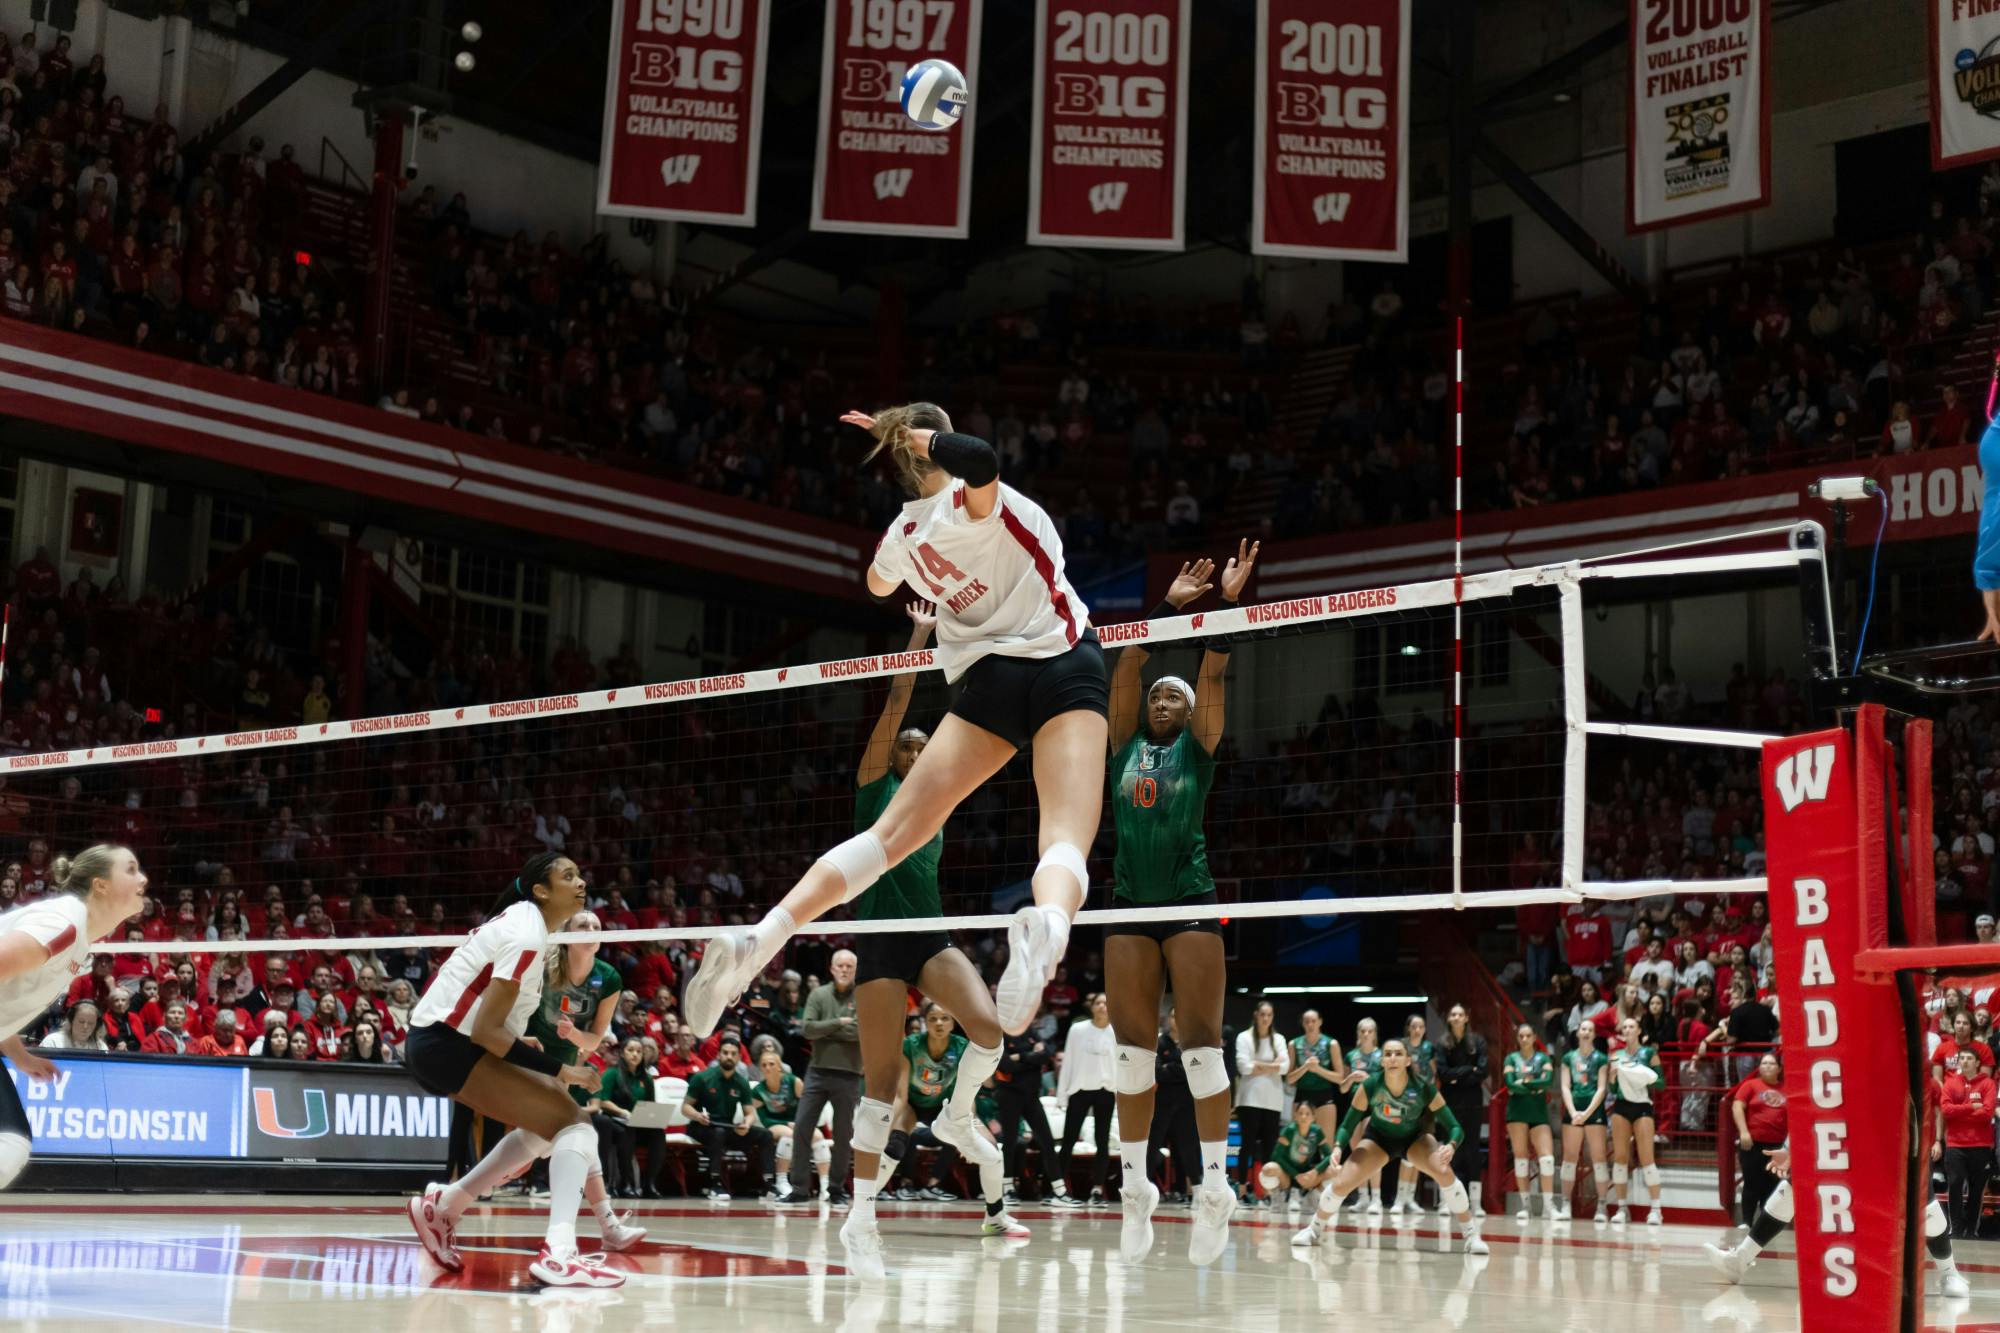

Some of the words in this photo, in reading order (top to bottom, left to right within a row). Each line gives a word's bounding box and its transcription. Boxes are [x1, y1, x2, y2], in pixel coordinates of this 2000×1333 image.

[847, 0, 955, 52] 1997
[1054, 11, 1170, 66] 2000
[1280, 19, 1383, 77] 2001
[1648, 32, 1747, 70] VOLLEYBALL
[1647, 53, 1747, 98] FINALIST
[629, 94, 740, 121] VOLLEYBALL
[841, 110, 949, 133] VOLLEY
[626, 114, 739, 144] CHAMPIONS
[838, 129, 950, 156] CHAMPIONS
[1054, 124, 1164, 146] VOLLEYBALL
[1277, 133, 1386, 157] VOLLEYBALL
[660, 154, 701, 187] W
[1052, 144, 1163, 169] CHAMPIONS
[1277, 153, 1386, 180] CHAMPIONS
[873, 168, 914, 201] W
[1088, 181, 1129, 214] W
[1313, 192, 1351, 225] W
[909, 542, 967, 597] 14
[946, 578, 989, 615] MREK
[1245, 598, 1323, 624] WISCONSIN
[1328, 587, 1397, 614] BADGERS
[1099, 621, 1149, 643] ADGERS
[819, 657, 878, 679] WISCONSIN
[882, 650, 934, 672] BADGERS
[644, 680, 697, 700] WISCONSIN
[700, 674, 745, 694] BADGERS
[488, 700, 535, 718] WISCONSIN
[538, 695, 579, 713] BADGERS
[224, 731, 262, 747] WISCONSIN
[265, 728, 298, 744] BADGERS
[350, 716, 391, 734] WISCONSIN
[393, 713, 431, 729] BADGERS
[9, 754, 40, 768] WISCONSIN
[42, 752, 69, 766] BADGERS
[112, 744, 145, 758] WISCONSIN
[148, 741, 177, 754] BADGERS
[1132, 775, 1157, 808] 10
[1775, 744, 1836, 814] W
[27, 1071, 72, 1101] BY
[1794, 878, 1857, 1297] BADGERS
[26, 1105, 208, 1142] WISCONSIN
[252, 1087, 329, 1139] U
[335, 1093, 449, 1138] MIAMI
